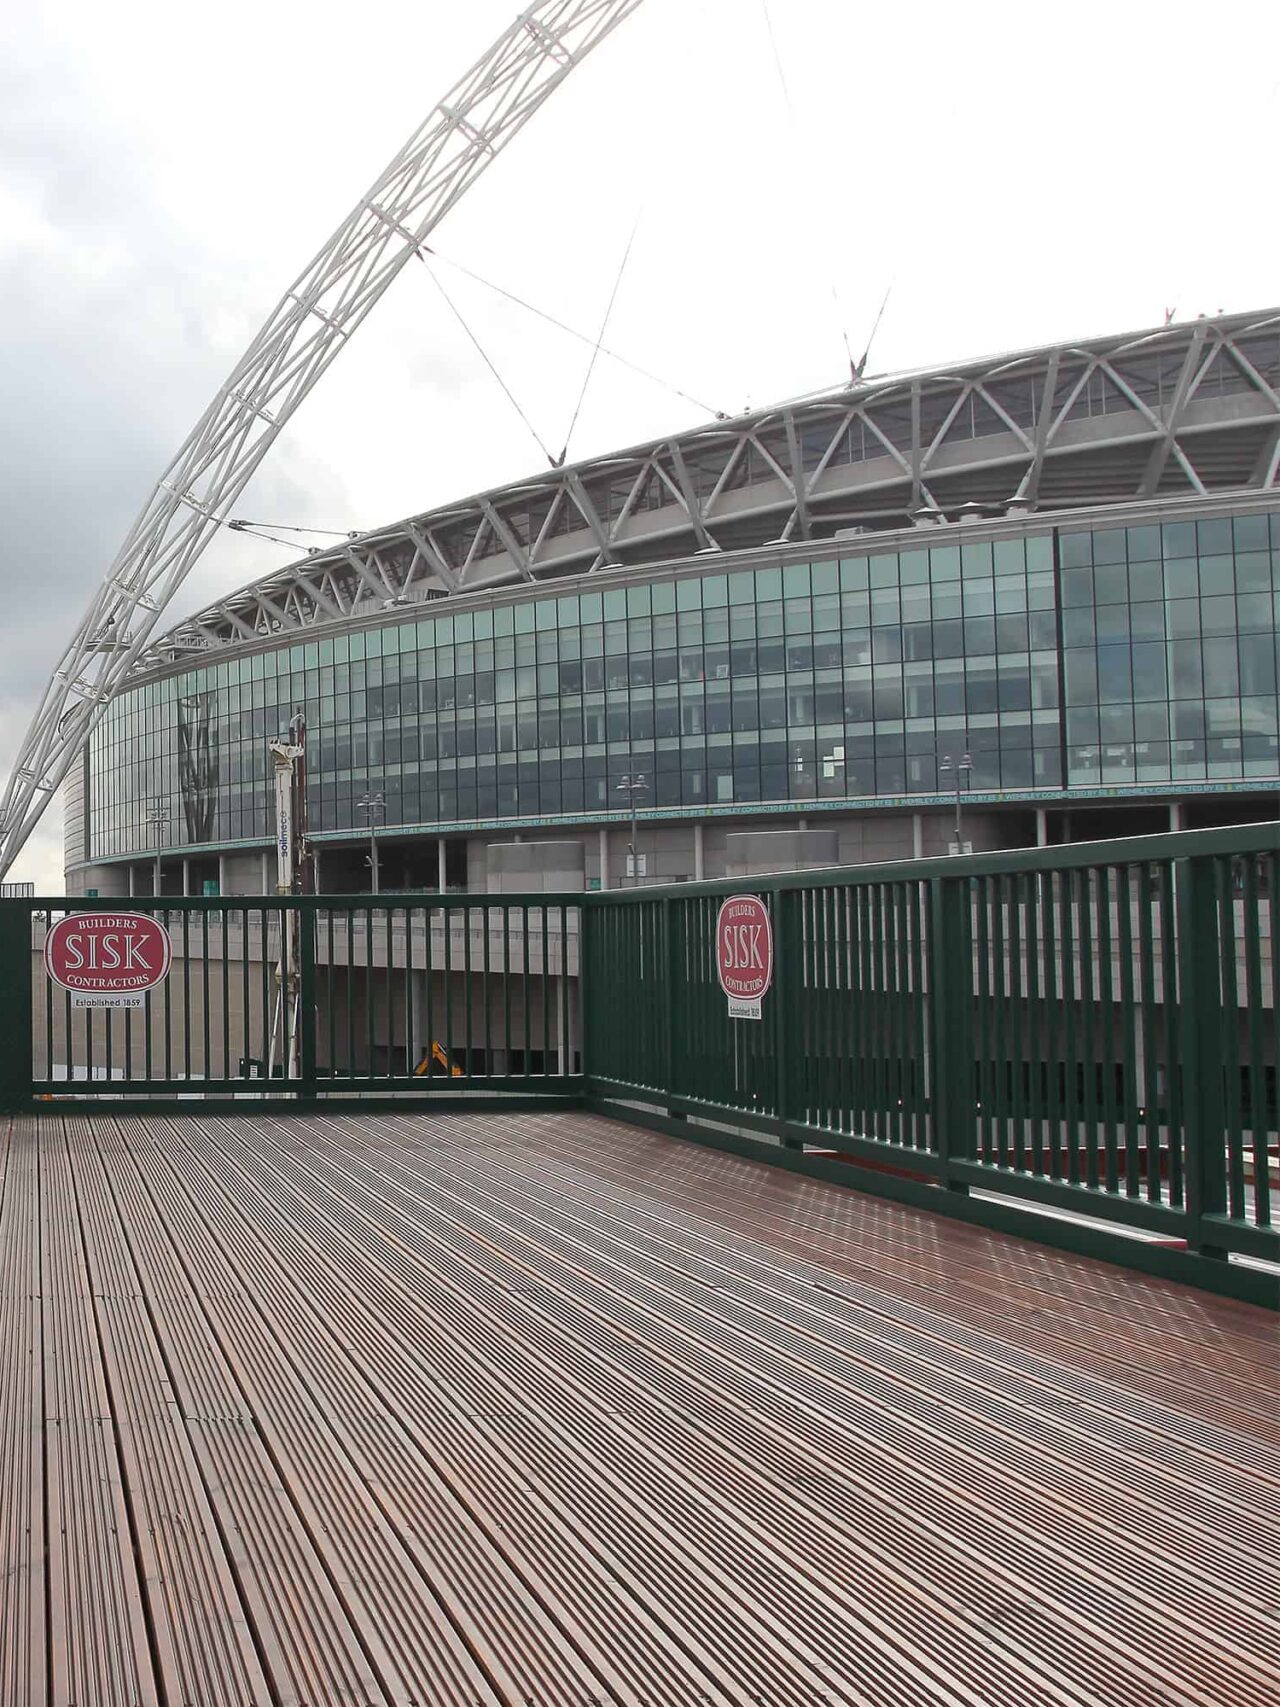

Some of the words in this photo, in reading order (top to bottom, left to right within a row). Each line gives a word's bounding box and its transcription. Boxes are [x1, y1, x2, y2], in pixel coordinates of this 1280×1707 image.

[835, 800, 874, 808] CONNECTED
[901, 797, 934, 805] WEMBLEY
[1005, 792, 1040, 800] WEMBLEY
[1042, 789, 1088, 799] CONNECTED
[1155, 784, 1202, 794] CONNECTED
[279, 818, 288, 857] soilmec
[729, 904, 755, 918] BUILDERS
[78, 918, 137, 929] BUILDERS
[65, 934, 153, 970] SISK
[725, 924, 763, 969] SISK
[67, 974, 149, 987] CONTRACTORS
[726, 975, 763, 992] CONTRACTORS
[76, 999, 120, 1007] Established
[123, 999, 141, 1007] 1859
